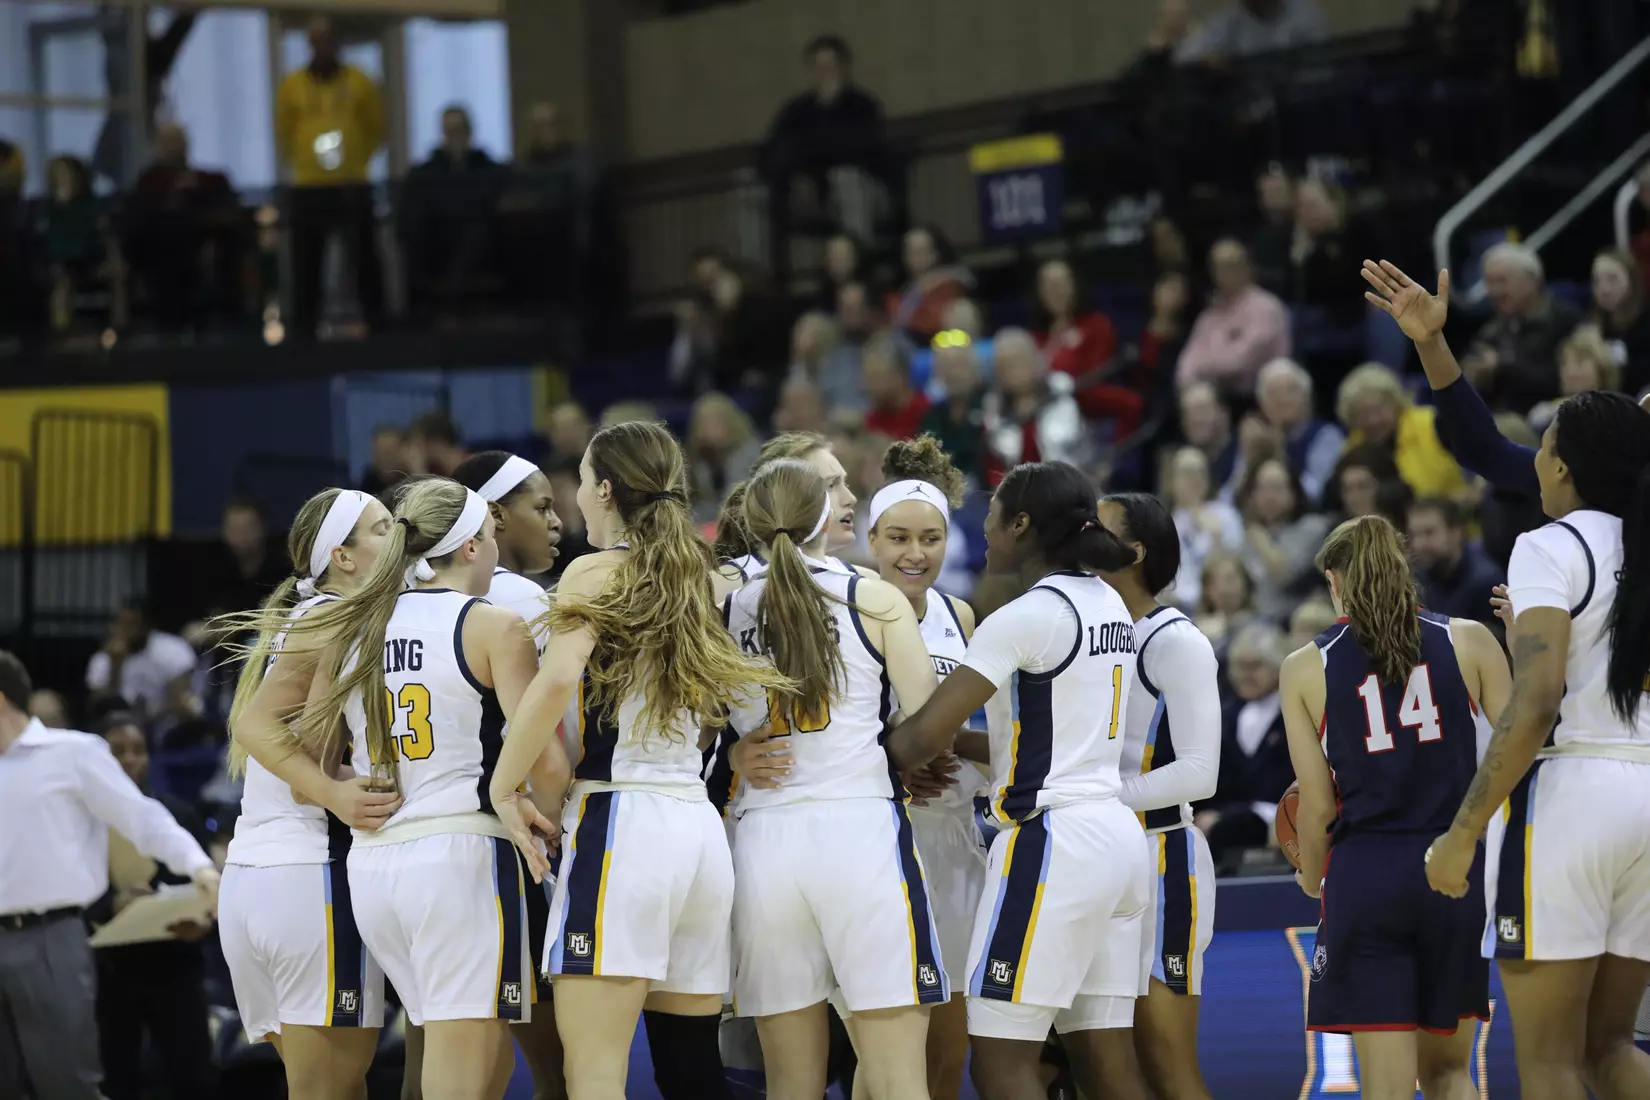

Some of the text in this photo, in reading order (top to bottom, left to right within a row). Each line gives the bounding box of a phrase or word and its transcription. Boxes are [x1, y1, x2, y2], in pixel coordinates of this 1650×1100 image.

[383, 638, 424, 675] ING
[1108, 664, 1122, 740] 1
[1355, 661, 1443, 754] 14
[1498, 917, 1520, 941] MU
[568, 933, 591, 956] MU
[919, 965, 938, 985] MU
[989, 960, 1012, 984] MU
[1166, 956, 1184, 976] MU
[339, 991, 358, 1012] MU
[502, 983, 521, 1005] MU
